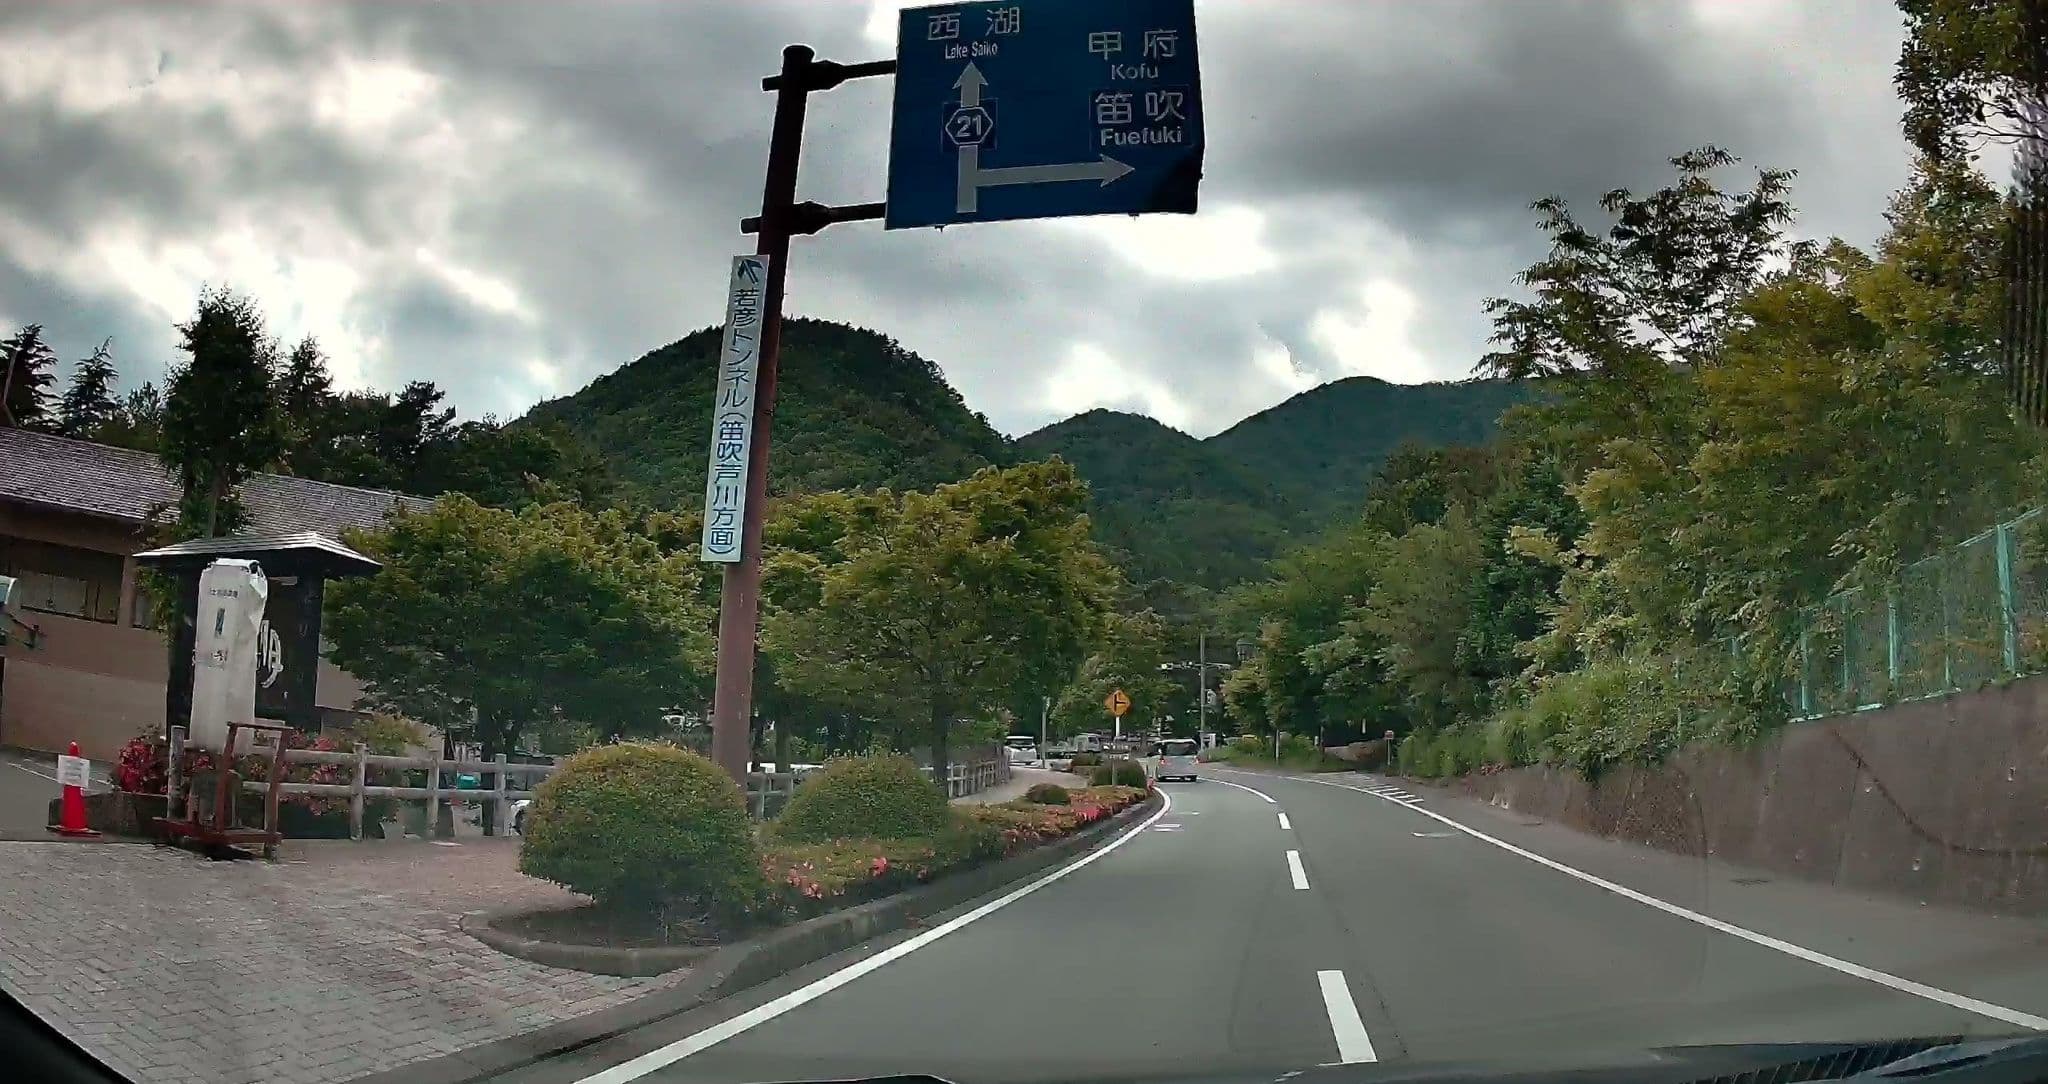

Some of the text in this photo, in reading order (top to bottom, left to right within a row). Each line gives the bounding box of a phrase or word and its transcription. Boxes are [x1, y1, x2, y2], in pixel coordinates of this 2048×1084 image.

[928, 6, 1020, 41] 西湖
[945, 41, 998, 59] Lake Saiko
[1089, 28, 1179, 61] 甲府
[1111, 63, 1159, 80] Kofu
[1095, 90, 1186, 124] 笛吹
[955, 113, 982, 137] 21
[1101, 126, 1182, 146] Fuefuki
